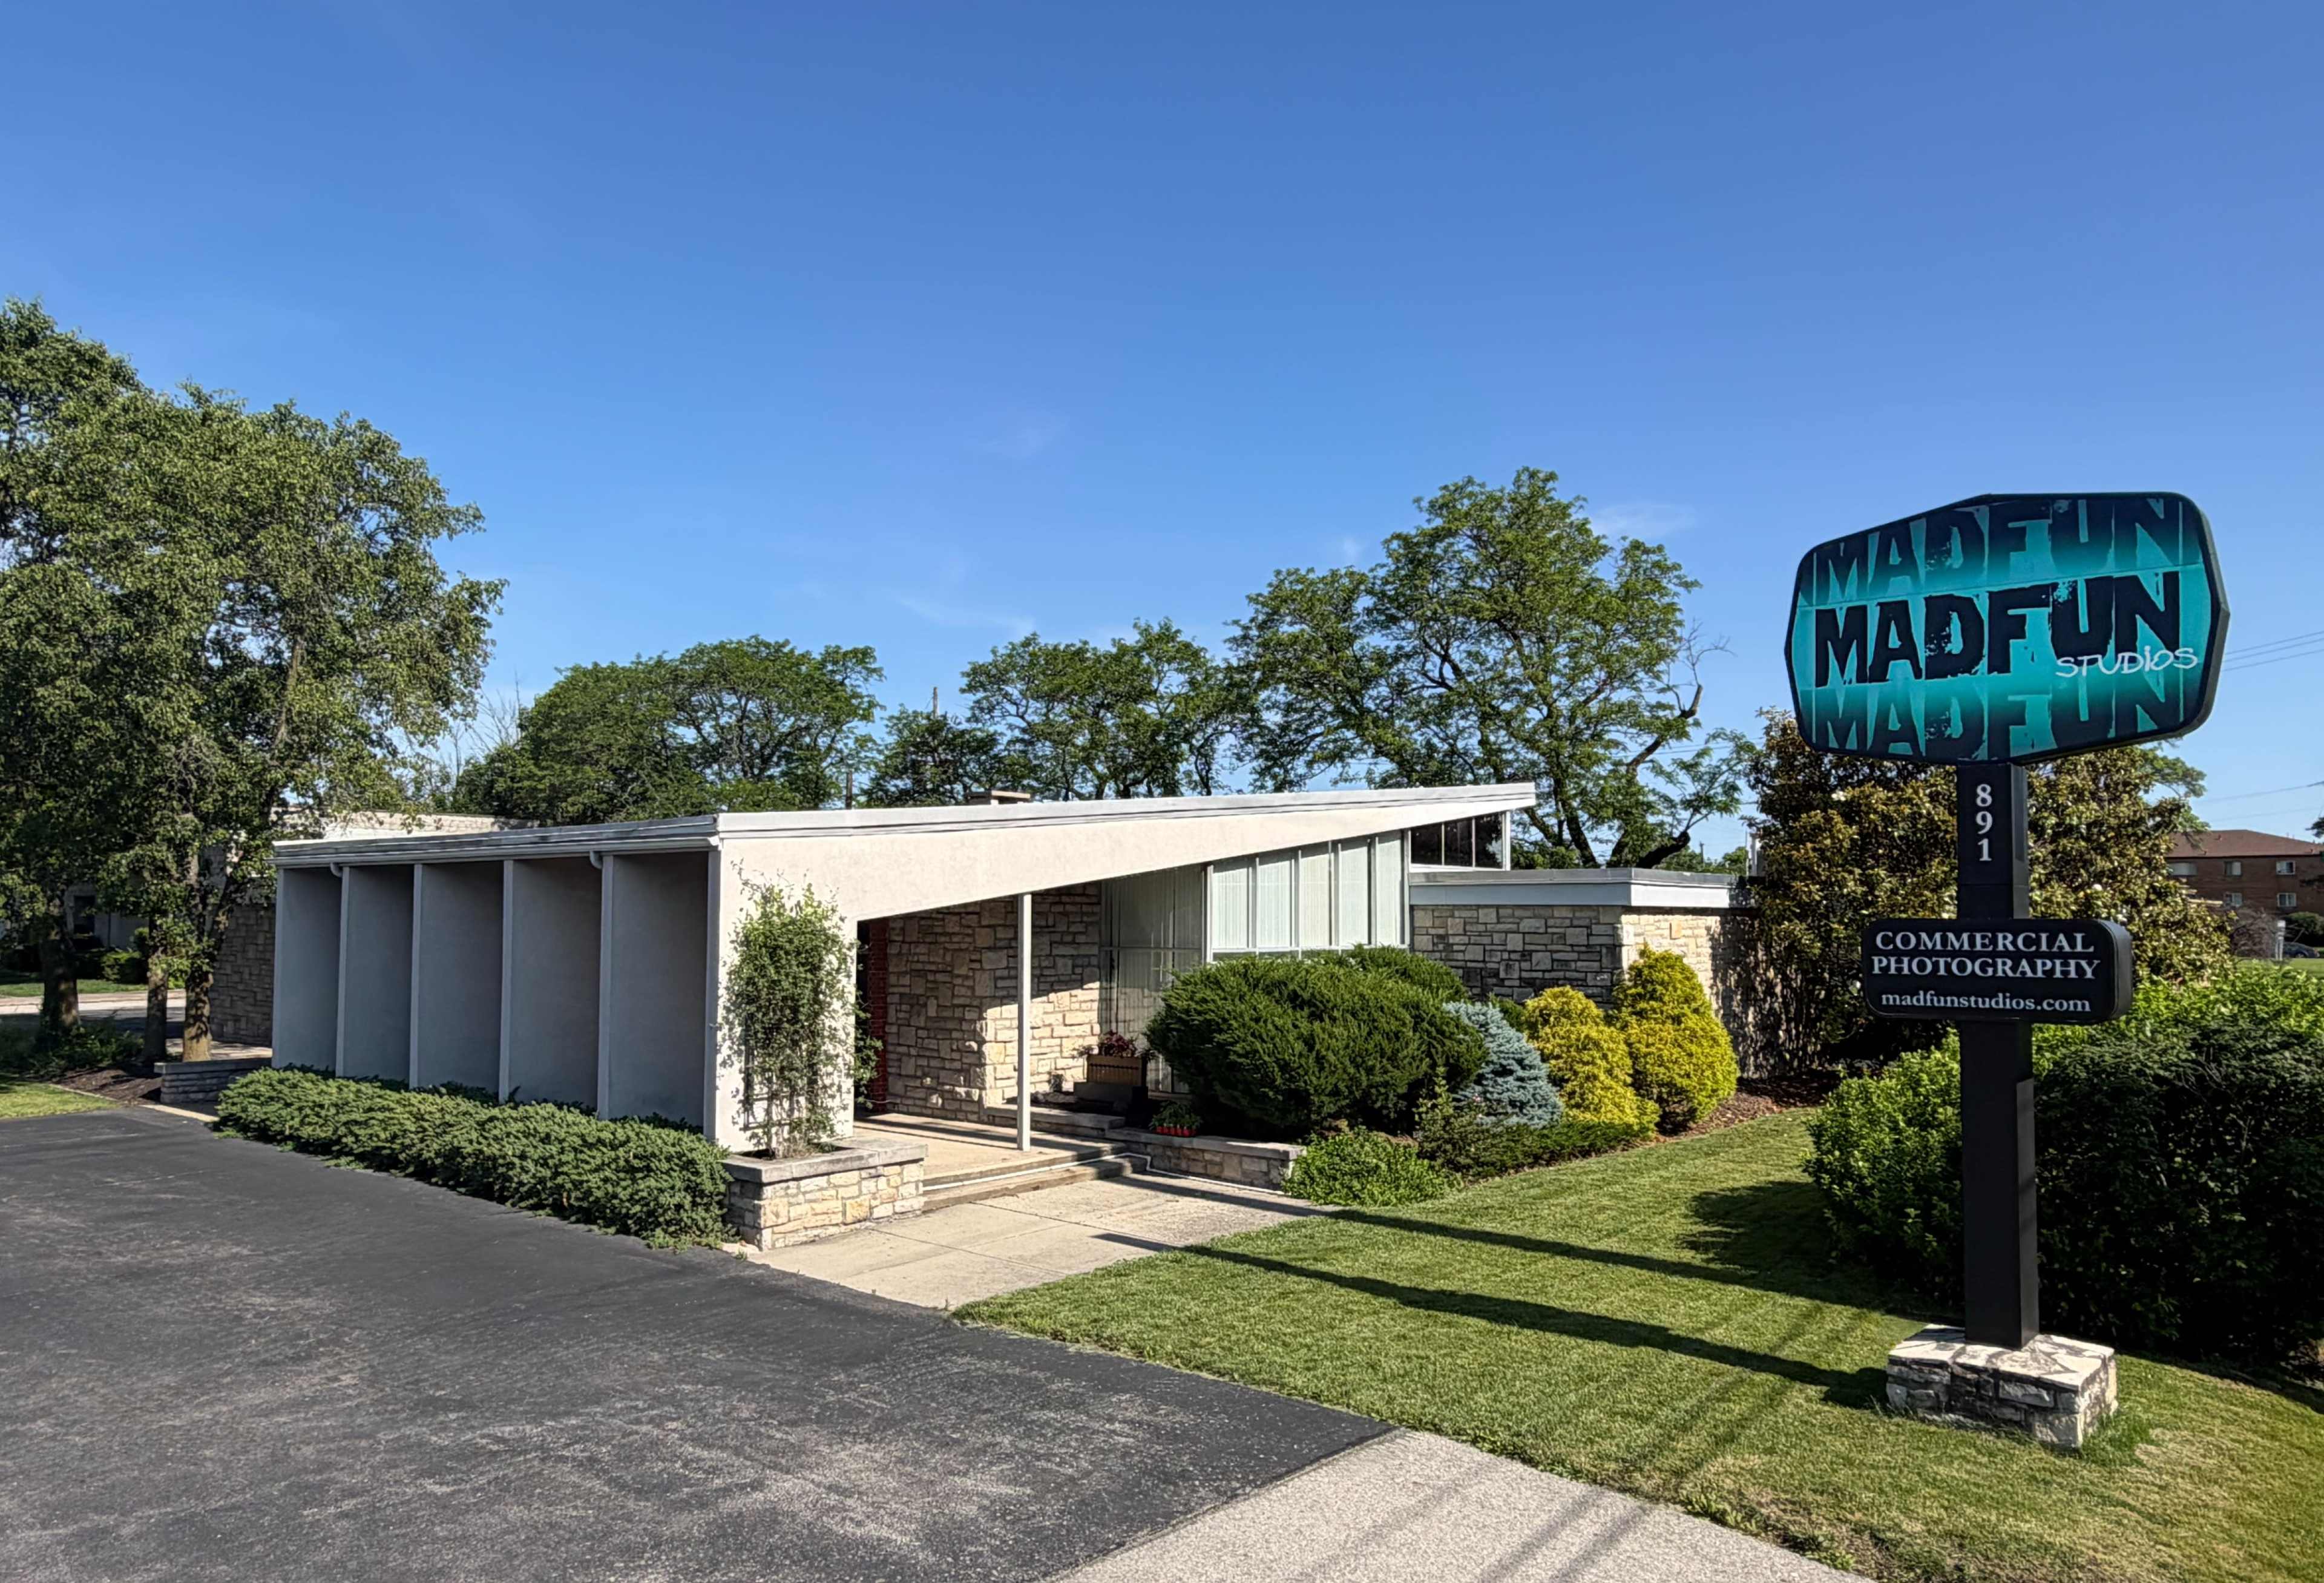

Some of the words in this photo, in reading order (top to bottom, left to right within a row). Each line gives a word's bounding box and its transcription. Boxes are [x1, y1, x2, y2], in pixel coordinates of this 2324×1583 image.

[1814, 570, 2180, 688] MADFUN
[1975, 783, 1993, 861] 891
[1875, 931, 2094, 952] COMMERCIAL
[1871, 955, 2101, 979] PHOTOGRAPHY
[1881, 990, 2091, 1012] madfunstudios.com
